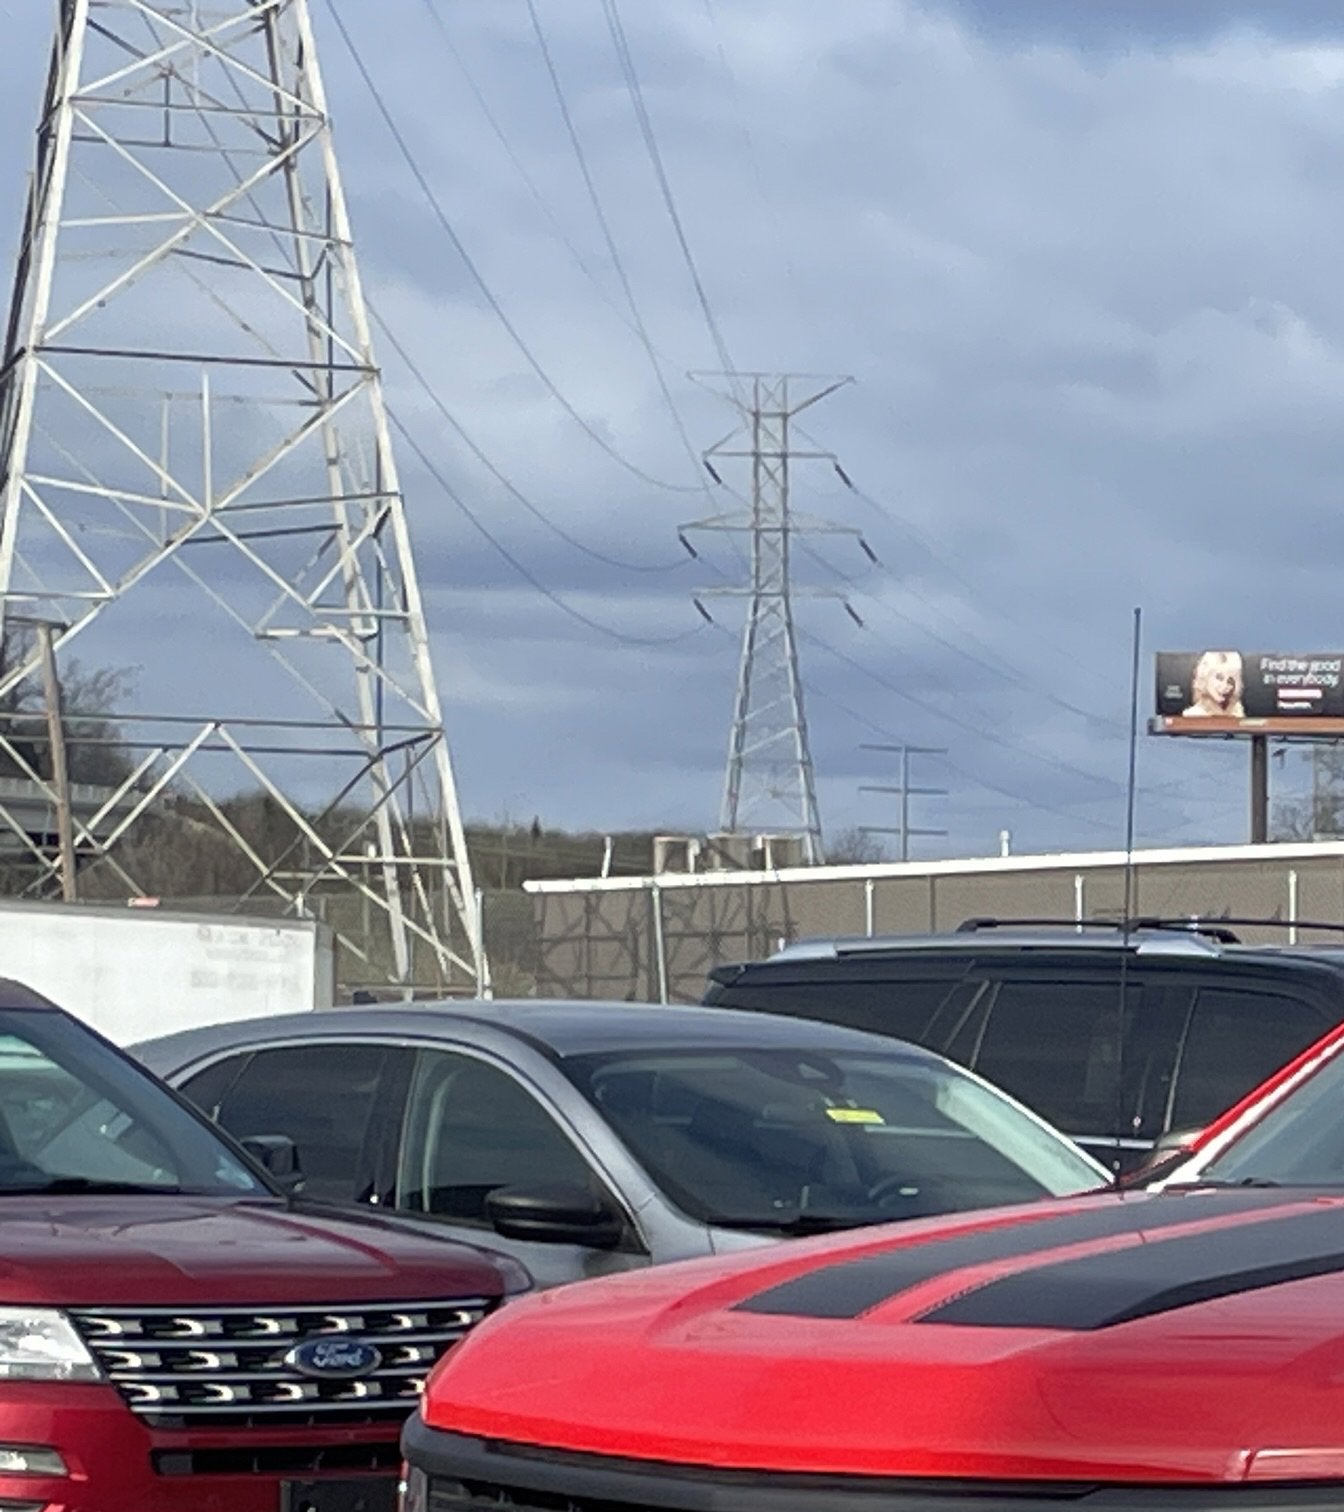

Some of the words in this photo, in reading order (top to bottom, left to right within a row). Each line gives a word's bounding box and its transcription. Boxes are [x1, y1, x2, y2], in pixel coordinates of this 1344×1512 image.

[1260, 657, 1286, 671] Find
[1287, 658, 1308, 671] the
[1309, 659, 1341, 673] good
[1263, 673, 1276, 685] in
[1276, 672, 1339, 688] everybody
[313, 1343, 363, 1368] Ford
